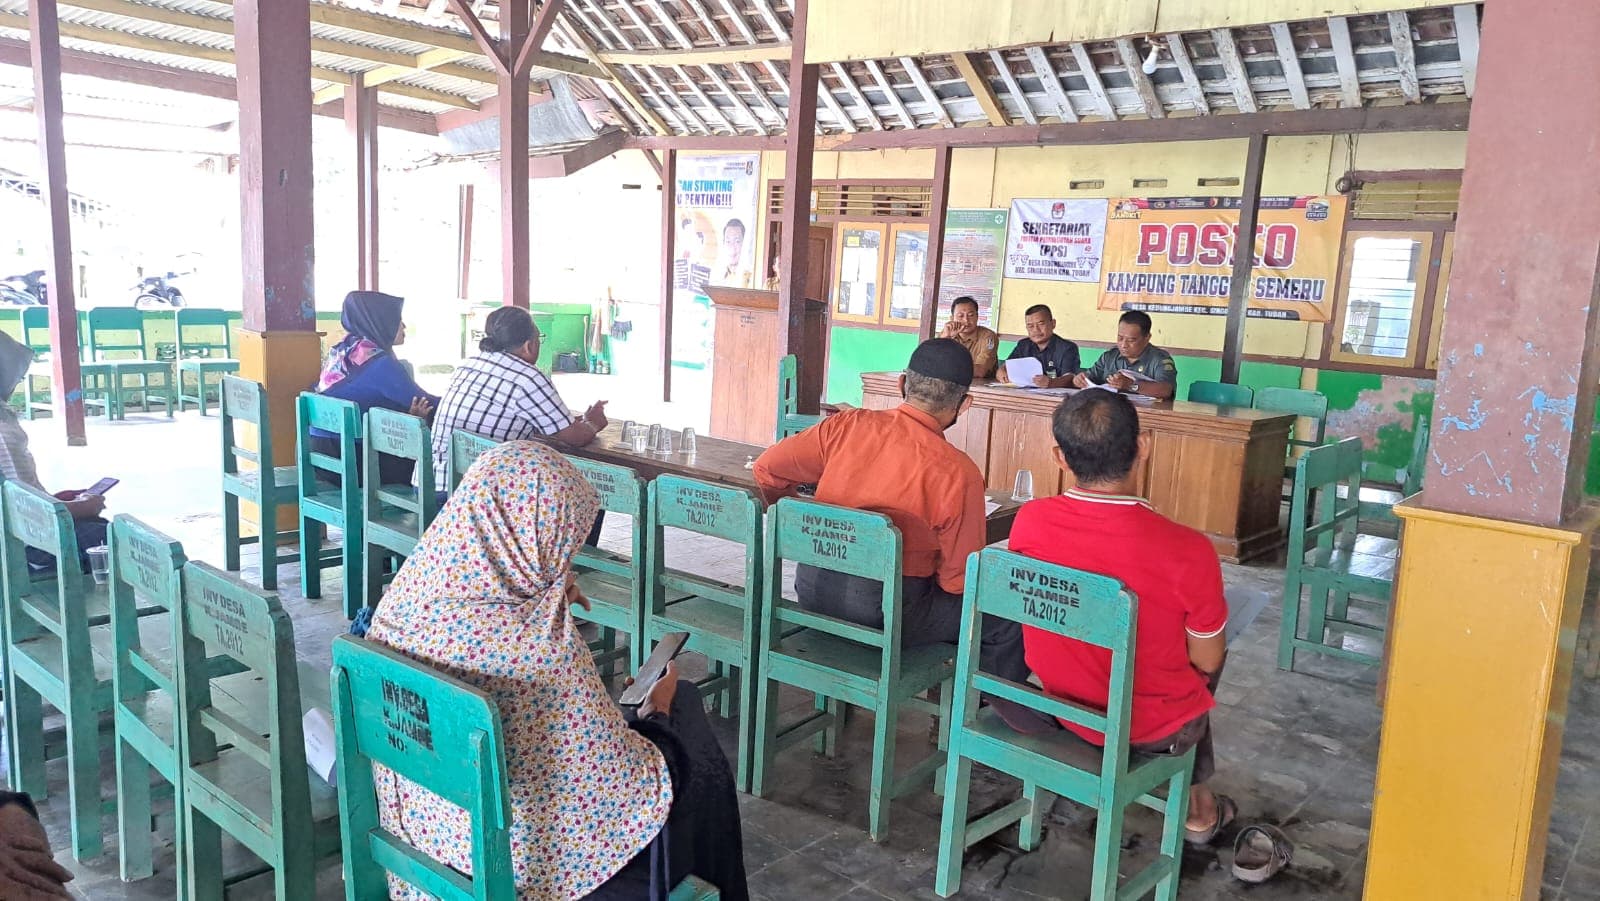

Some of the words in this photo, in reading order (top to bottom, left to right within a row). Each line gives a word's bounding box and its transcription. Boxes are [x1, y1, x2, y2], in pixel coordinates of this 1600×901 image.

[695, 180, 733, 192] STUNTING
[685, 193, 732, 206] PENTING!!!
[1022, 222, 1091, 236] SEKRETARIAT
[1106, 272, 1176, 294] KAMPUNG
[1180, 275, 1232, 296] TANGG
[1255, 277, 1326, 301] SEMERU
[590, 471, 614, 483] DESA
[676, 486, 694, 497] INV
[695, 489, 722, 502] DESA
[686, 509, 716, 528] TA.2012
[803, 513, 822, 526] INV
[824, 517, 856, 532] DESA
[801, 526, 857, 543] K.JAMBE
[812, 538, 848, 560] TA.2012
[1011, 567, 1036, 582] INV
[1039, 574, 1080, 594] DESA
[203, 586, 219, 605] INV
[220, 594, 247, 618] DESA
[1009, 581, 1080, 608] K.JAMBE
[1023, 596, 1067, 626] TA.2012
